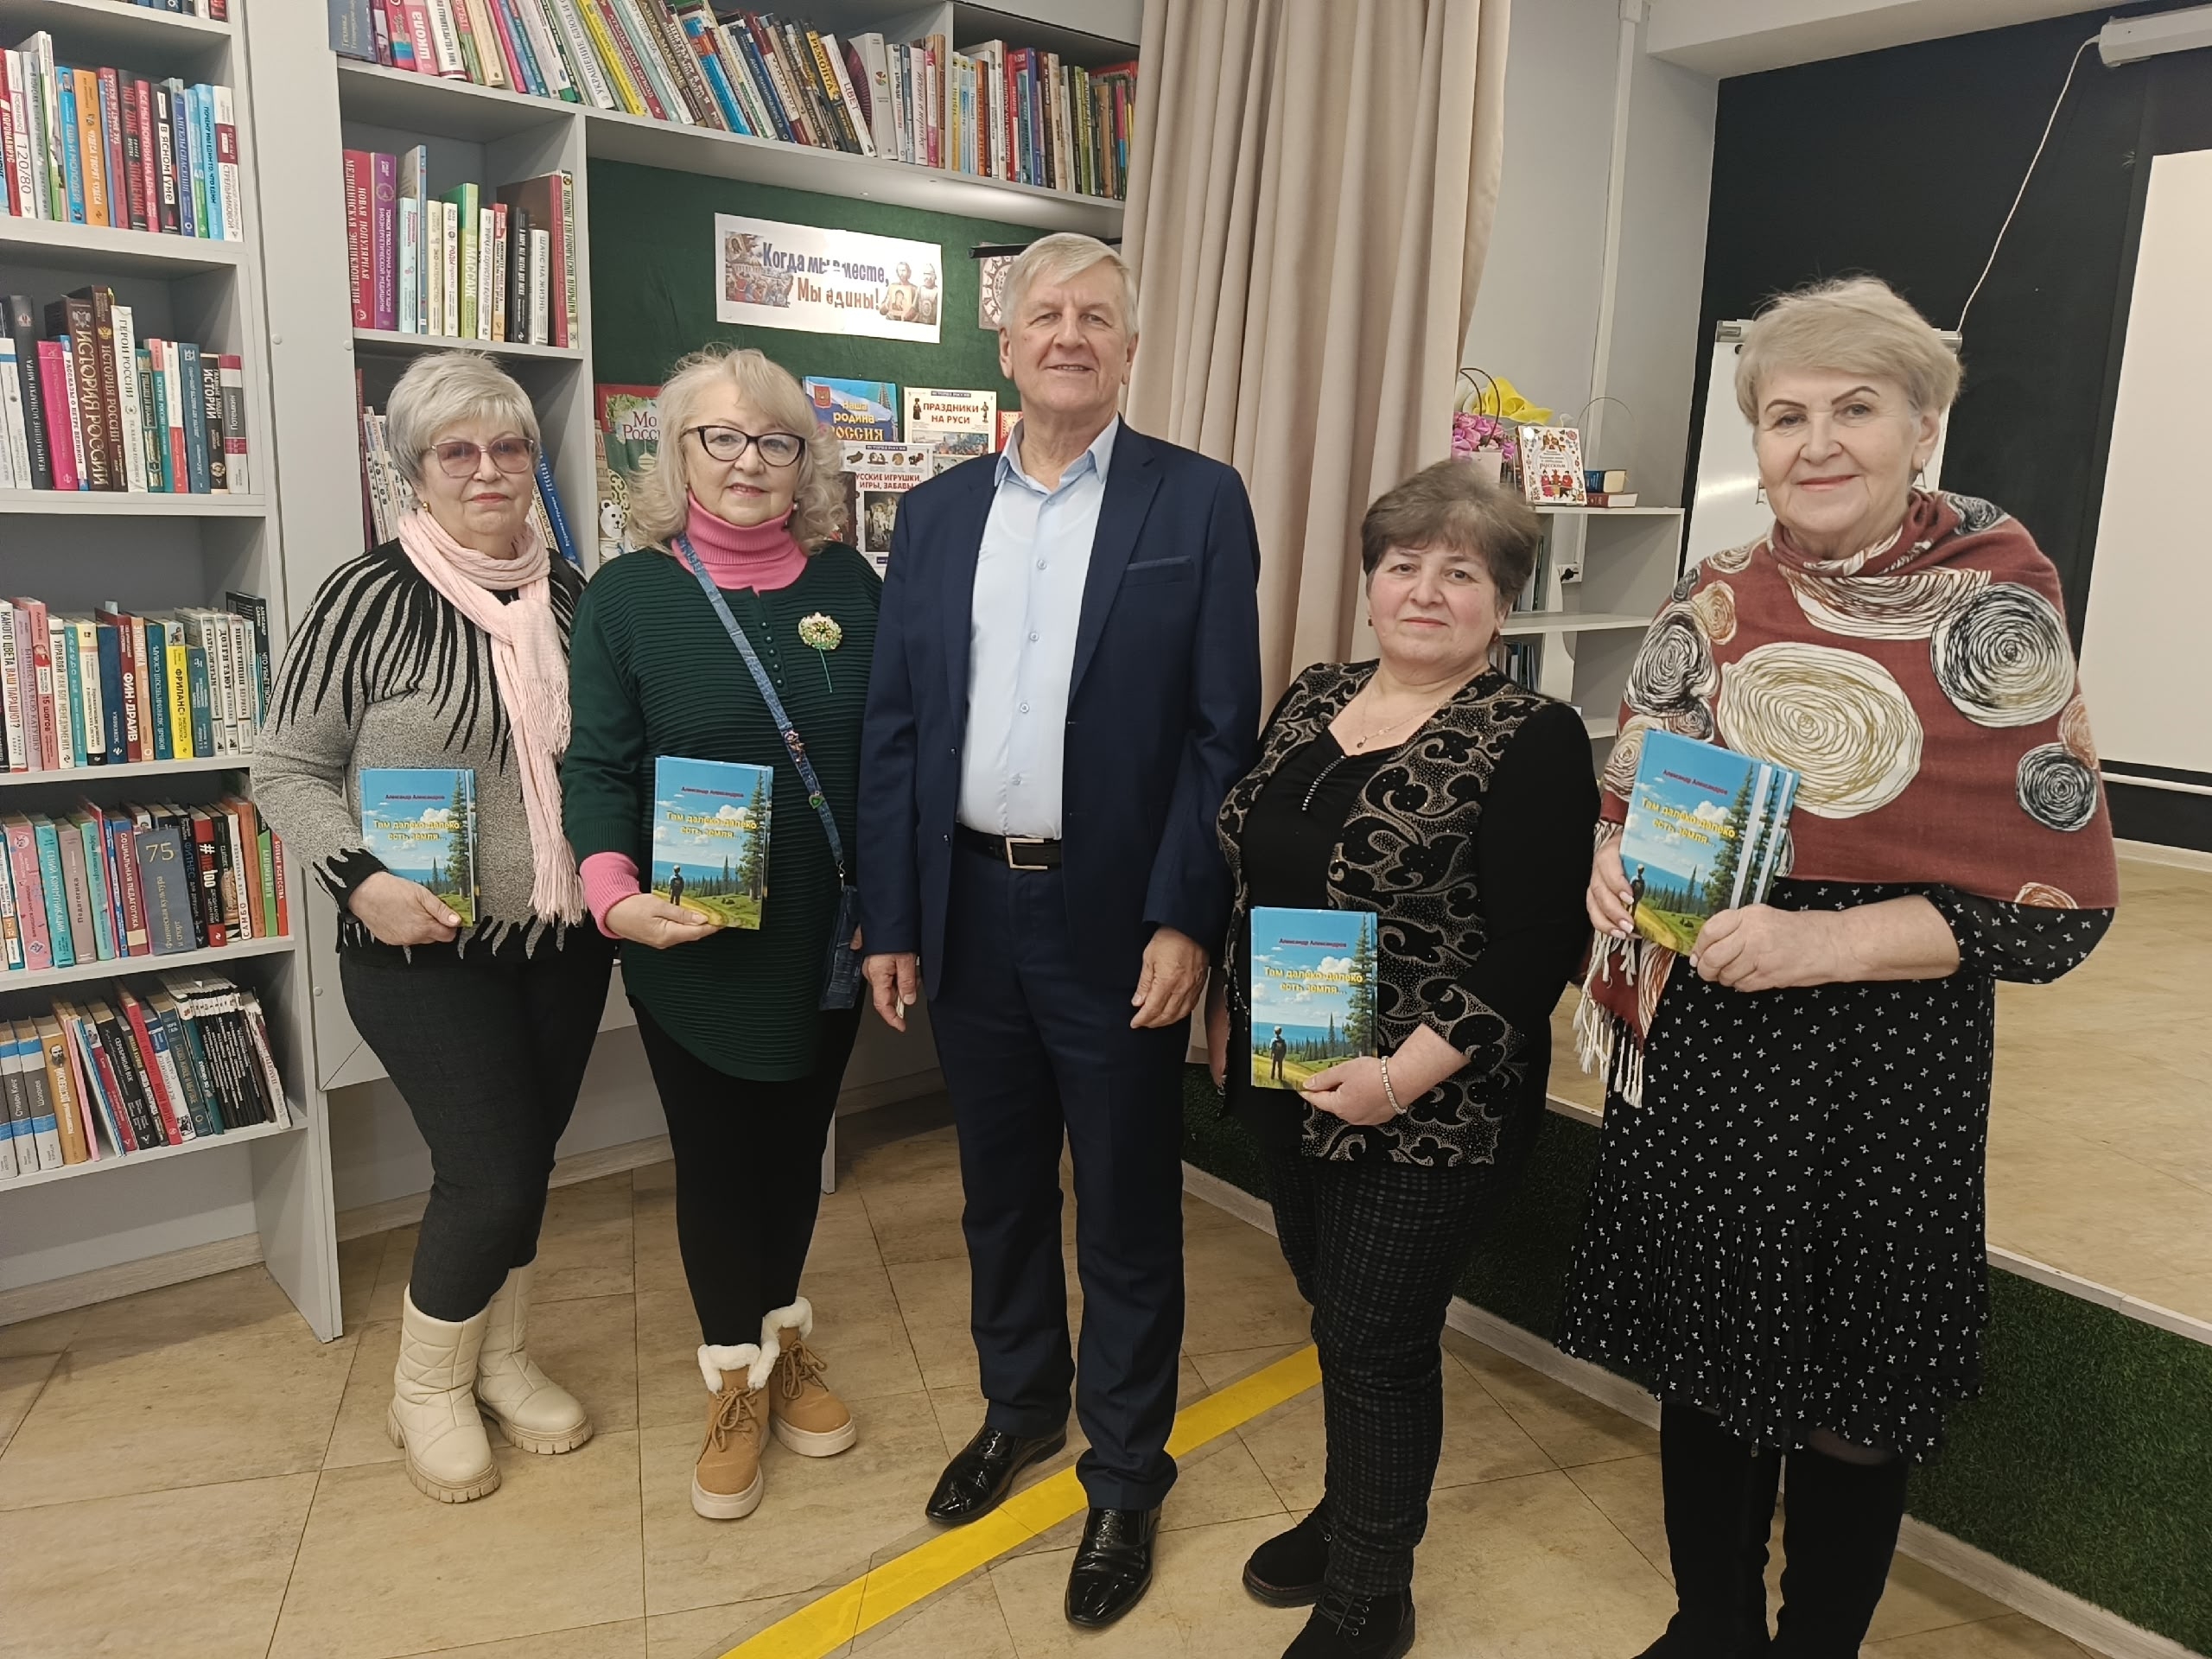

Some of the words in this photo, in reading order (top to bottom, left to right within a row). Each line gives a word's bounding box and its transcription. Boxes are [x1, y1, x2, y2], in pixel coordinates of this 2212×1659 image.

[564, 13, 582, 40] БЛЮД
[638, 18, 658, 54] ОДЕЖДА
[641, 1, 662, 38] АЗБУКА
[659, 37, 685, 86] МАКРАМЕ
[574, 41, 605, 95] УКРАШЕНИЕ
[808, 37, 835, 91] РЕМОНТА
[842, 81, 860, 111] ЦВЕТ
[125, 110, 137, 135] ZONE
[141, 107, 149, 119] МЫ
[3, 112, 15, 162] КОРОНАВИРУС
[88, 130, 98, 153] ЧУДЕСА
[142, 122, 151, 161] ТВОРЕНИЯ
[176, 115, 186, 149] АНГЕЛЫ
[205, 132, 211, 142] МЫ
[16, 144, 31, 194] 120/80
[90, 156, 99, 179] ТВОРЯТ
[144, 163, 151, 173] НА
[180, 149, 189, 192] СПАСЕНИЯ
[92, 181, 103, 205] ЧУДЕСА
[130, 162, 143, 215] ЭПИДЕМИЯ
[223, 165, 233, 229] СТРЕЛЬНИКОВОЙ
[345, 159, 358, 227] МЕДИЦИНСКАЯ
[358, 188, 368, 216] НОВАЯ
[359, 221, 369, 279] ПОПУЛЯРНАЯ
[564, 220, 574, 276] ГЕОГРАФИЧЕСКИЕ
[763, 242, 804, 272] Когда
[348, 232, 360, 304] ЭНЦИКЛОПЕДИЯ
[466, 247, 475, 297] МАССАЖ
[539, 266, 545, 277] НА
[567, 279, 576, 313] ОТКРЫТИЯ
[798, 277, 821, 302] Мы
[826, 287, 880, 310] едины!
[119, 320, 131, 353] ГЕРОИ
[66, 359, 74, 398] РАССКАЗЫ
[75, 329, 100, 410] ИСТОРИЯ
[101, 345, 114, 396] ИСТОРИЯ
[123, 356, 134, 397] РОССИИ
[29, 383, 40, 419] МОНАРХИ
[203, 369, 216, 419] ИСТОРИИ
[842, 400, 868, 411] Наша
[923, 403, 979, 413] ПРАЗДНИКИ
[71, 408, 79, 429] ПЕТРЕ
[107, 398, 119, 442] РОССИИ
[623, 424, 660, 441] Росс
[632, 411, 658, 428] Мо
[833, 412, 875, 424] родина
[834, 427, 884, 441] ОССИЯ
[947, 416, 970, 424] РУСИ
[33, 422, 45, 472] ВЕЛИЧАЙШИЕ
[74, 431, 83, 464] ВЕЛИКОМ
[86, 415, 109, 486] РОССИИ
[884, 474, 921, 483] ИГРУШКИ,
[1, 612, 12, 639] КАКОГО
[3, 643, 15, 666] ЦВЕТА
[133, 626, 145, 666] ЭКОНОМИКА
[235, 627, 245, 685] ИНВЕСТИЦИИ
[6, 668, 16, 684] ВАШ
[25, 648, 34, 679] БИЗНЕС
[28, 682, 35, 690] НА
[54, 640, 64, 673] УПРАВЛЯЙ
[60, 703, 69, 751] МЕНЕДЖМЕНТА
[175, 669, 185, 715] ФРИЛАНС:
[8, 687, 20, 728] ПАРАШЮТ?
[1662, 769, 1692, 785] Александр
[1692, 779, 1728, 796] Александров
[374, 820, 391, 829] Там
[393, 821, 461, 830] далеко-далеко
[666, 811, 684, 821] Там
[686, 816, 758, 830] далеко-далеко
[680, 826, 702, 835] есть
[1642, 798, 1661, 813] Там
[1661, 804, 1736, 838] далеко-далеко
[1652, 819, 1675, 833] есть
[47, 850, 57, 874] ГЕНИЙ
[120, 833, 133, 881] СОЦИАЛЬНАЯ
[145, 842, 175, 863] 75
[185, 842, 195, 879] ФИТНЕС
[263, 849, 272, 880] АНАТОМИЯ
[157, 876, 168, 907] культура
[276, 865, 284, 899] ИСКУССТВА
[50, 876, 65, 933] КОММУНИКАЦИИ
[73, 878, 83, 923] Педагогика
[126, 882, 139, 929] ПЕДАГОГИКА
[162, 909, 173, 949] Физическая
[1310, 940, 1347, 949] Александров
[1264, 967, 1283, 977] Там
[1286, 970, 1364, 982] далеко-далеко
[1280, 983, 1303, 992] есть
[115, 1038, 130, 1071] СЕРЕБРЯНЫЙ
[124, 1071, 133, 1083] ВЕК
[10, 1078, 20, 1093] Кинг
[35, 1080, 44, 1107] Шолохов
[13, 1094, 22, 1116] Стивен
